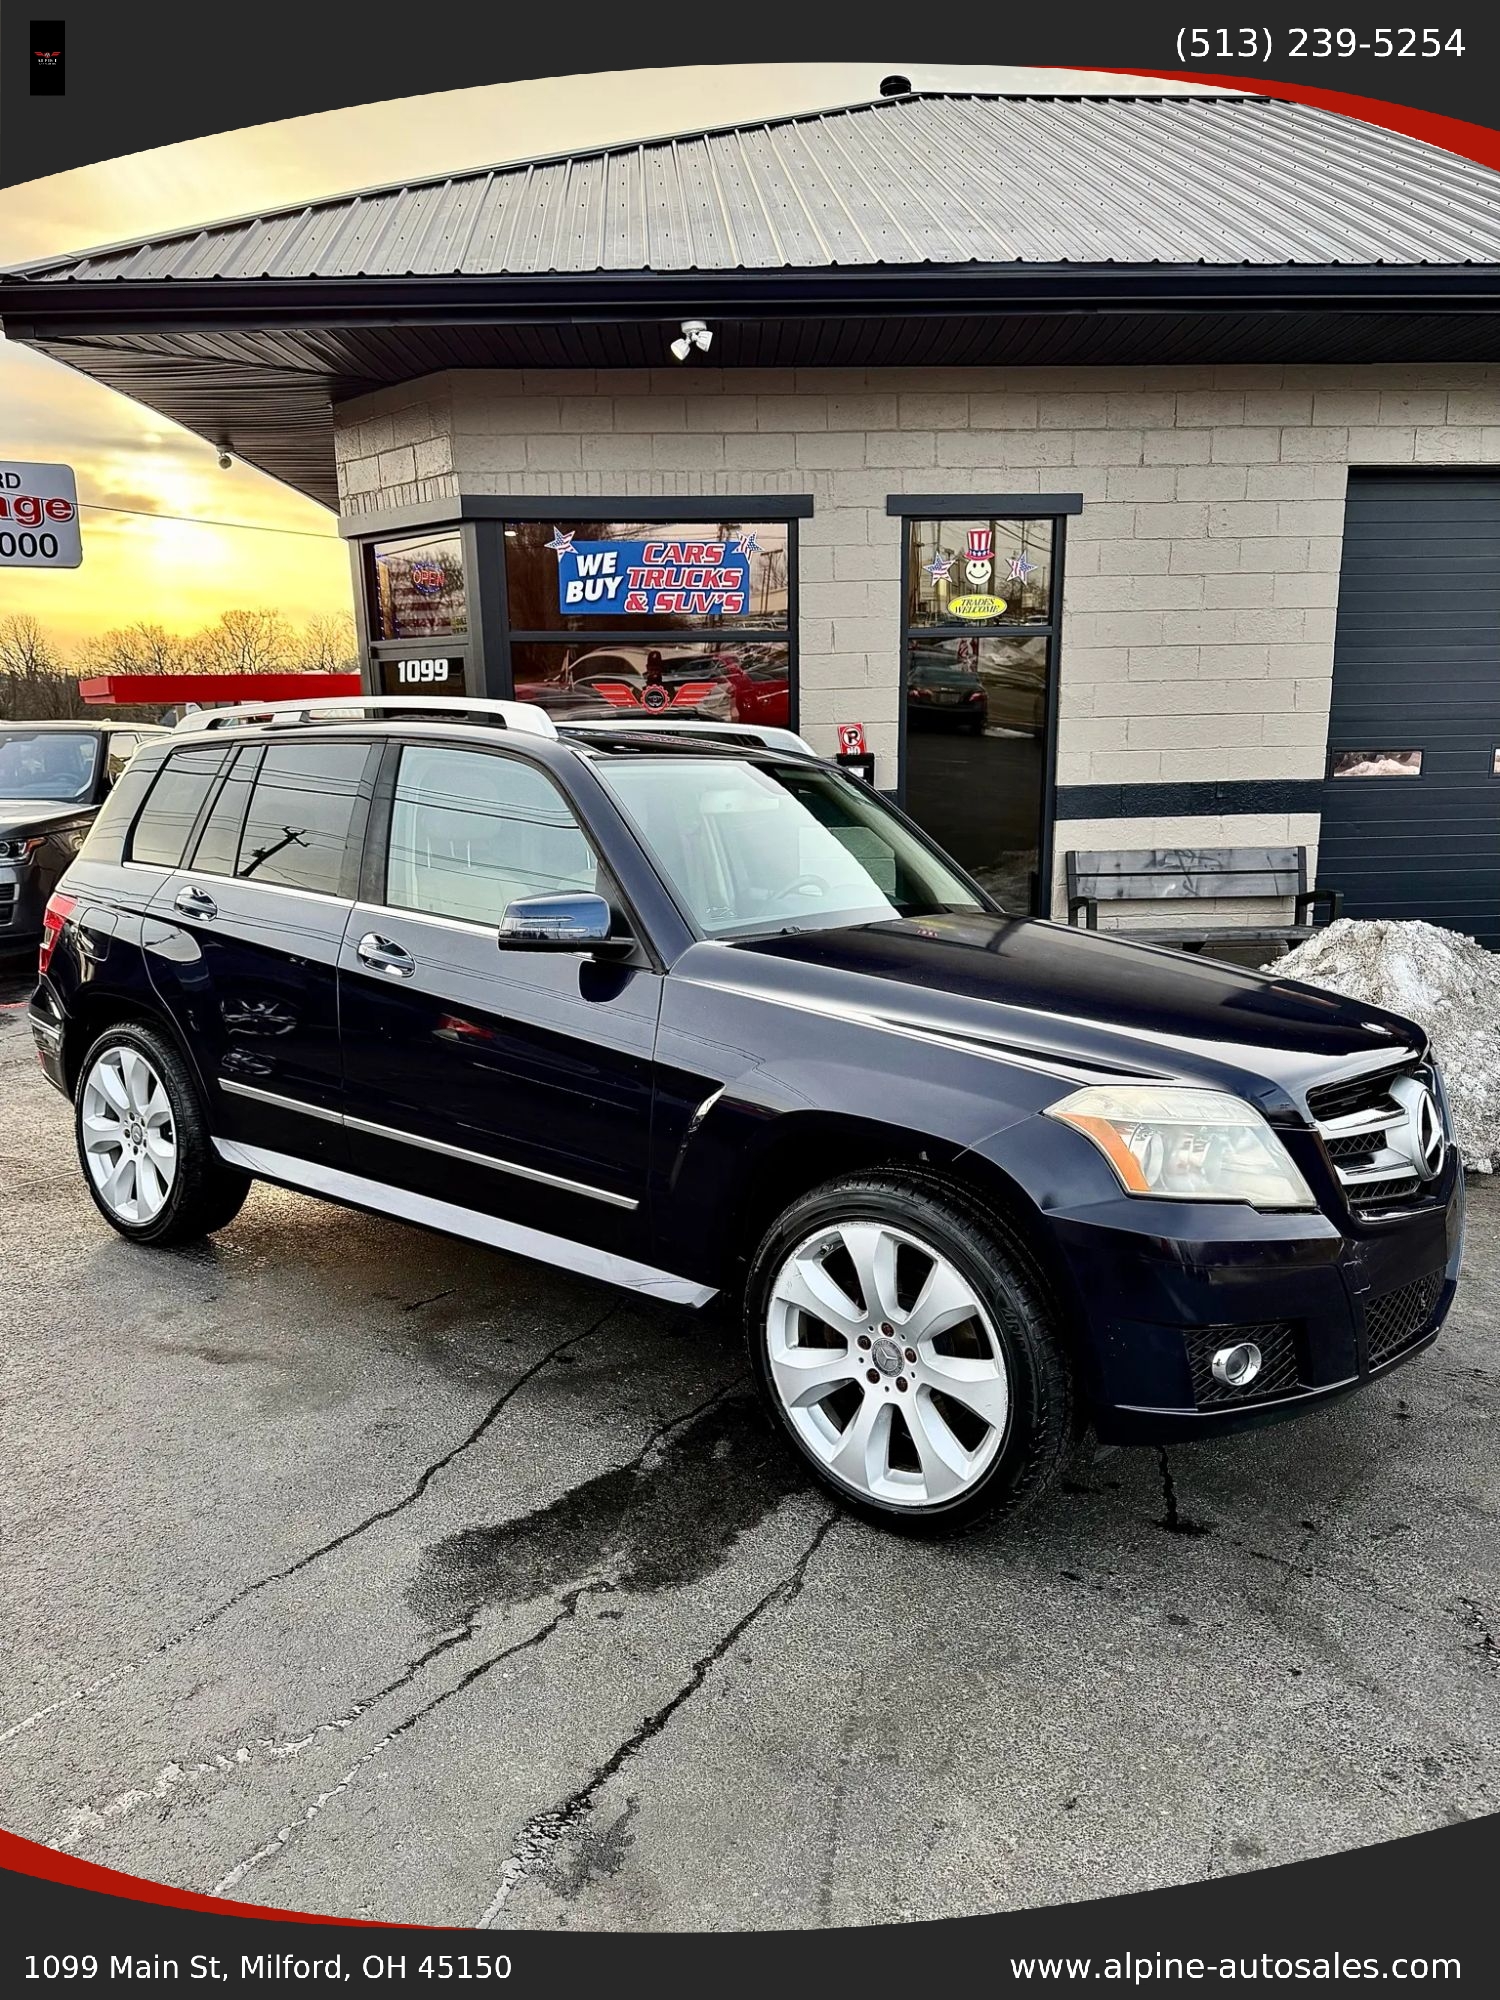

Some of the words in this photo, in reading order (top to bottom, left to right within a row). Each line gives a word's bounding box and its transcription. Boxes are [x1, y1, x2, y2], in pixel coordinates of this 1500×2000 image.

[0, 472, 21, 489] D
[0, 531, 59, 558] 000
[642, 543, 725, 565] CARS
[576, 551, 618, 577] WE
[413, 569, 445, 587] OPEN
[627, 566, 743, 589] TRUCKS
[566, 576, 623, 604] BUY
[624, 591, 649, 613] &
[653, 591, 744, 613] SUV'S
[955, 605, 1000, 614] WELCOME
[961, 598, 995, 606] TRADES
[398, 659, 449, 683] 1099
